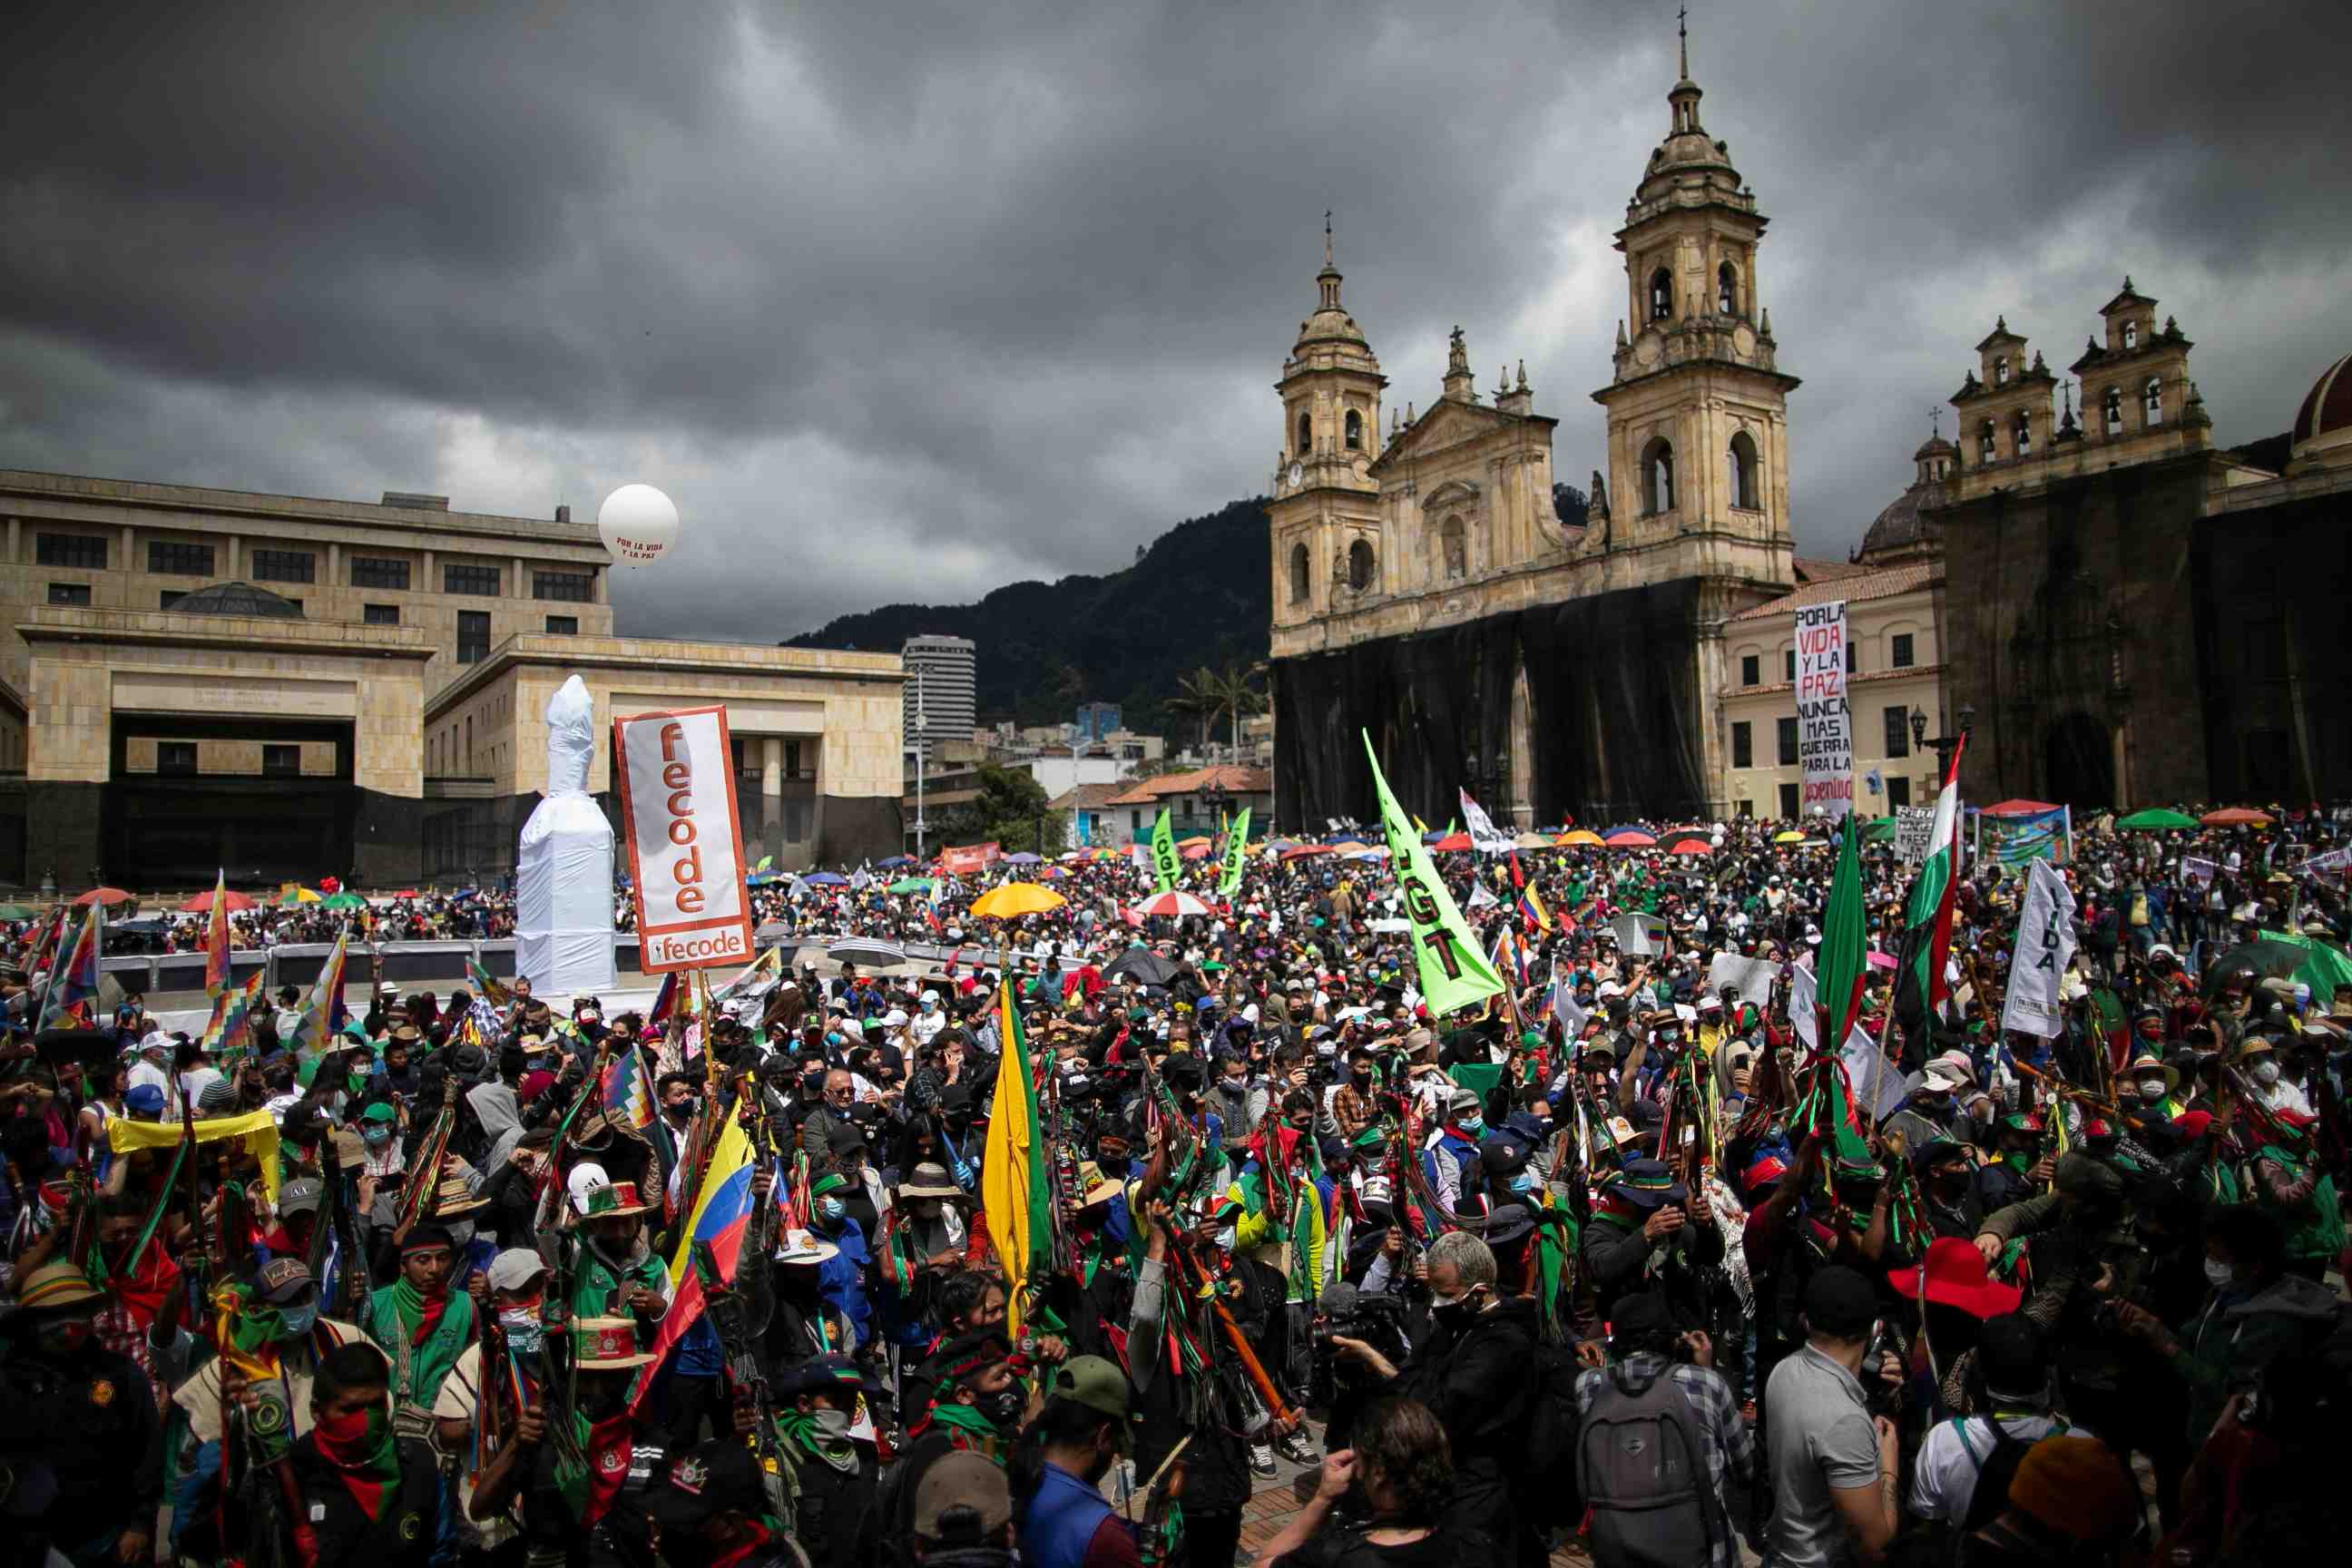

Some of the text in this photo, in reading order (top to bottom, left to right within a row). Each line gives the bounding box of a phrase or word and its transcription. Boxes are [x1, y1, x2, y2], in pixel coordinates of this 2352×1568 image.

[617, 537, 632, 548] POR
[634, 543, 643, 551] LA
[1799, 624, 1841, 654] VIDA
[1802, 652, 1839, 673] Y LA
[1802, 671, 1839, 698] PAZ
[1797, 698, 1849, 720] NUNCA
[1800, 739, 1850, 756] GUERRA
[661, 722, 706, 913] fecode
[663, 931, 740, 961] fecode
